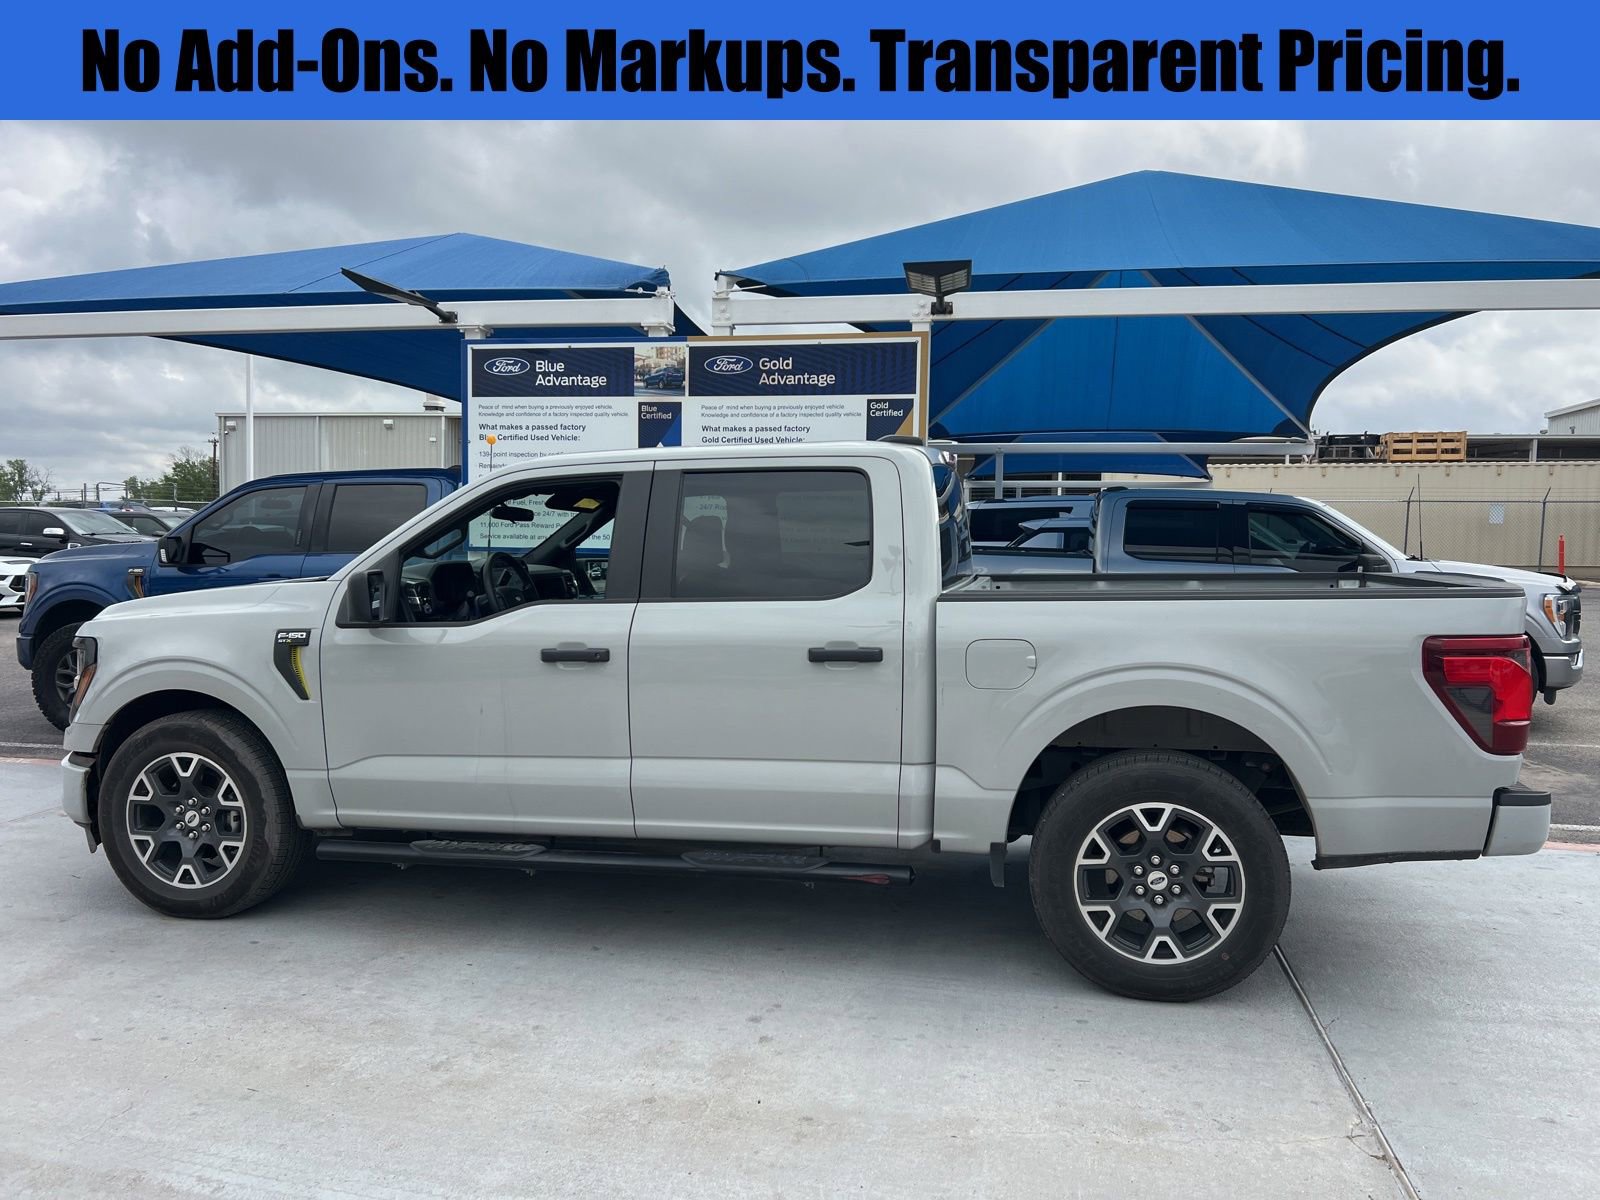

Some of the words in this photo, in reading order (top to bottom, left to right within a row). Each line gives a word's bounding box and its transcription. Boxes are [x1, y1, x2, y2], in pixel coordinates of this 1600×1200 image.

[535, 360, 565, 372] Blue
[758, 357, 793, 370] Gold
[535, 374, 607, 388] Advantage
[758, 373, 836, 387] Advantage
[641, 412, 672, 420] Certified
[870, 409, 904, 417] Certified
[532, 423, 559, 432] passed
[560, 423, 586, 432] factory
[755, 425, 782, 433] passed
[784, 425, 810, 433] factory
[497, 433, 528, 441] Certified
[530, 433, 549, 441] Used
[701, 436, 720, 444] Gold
[721, 436, 753, 444] Certified
[754, 436, 774, 444] Used
